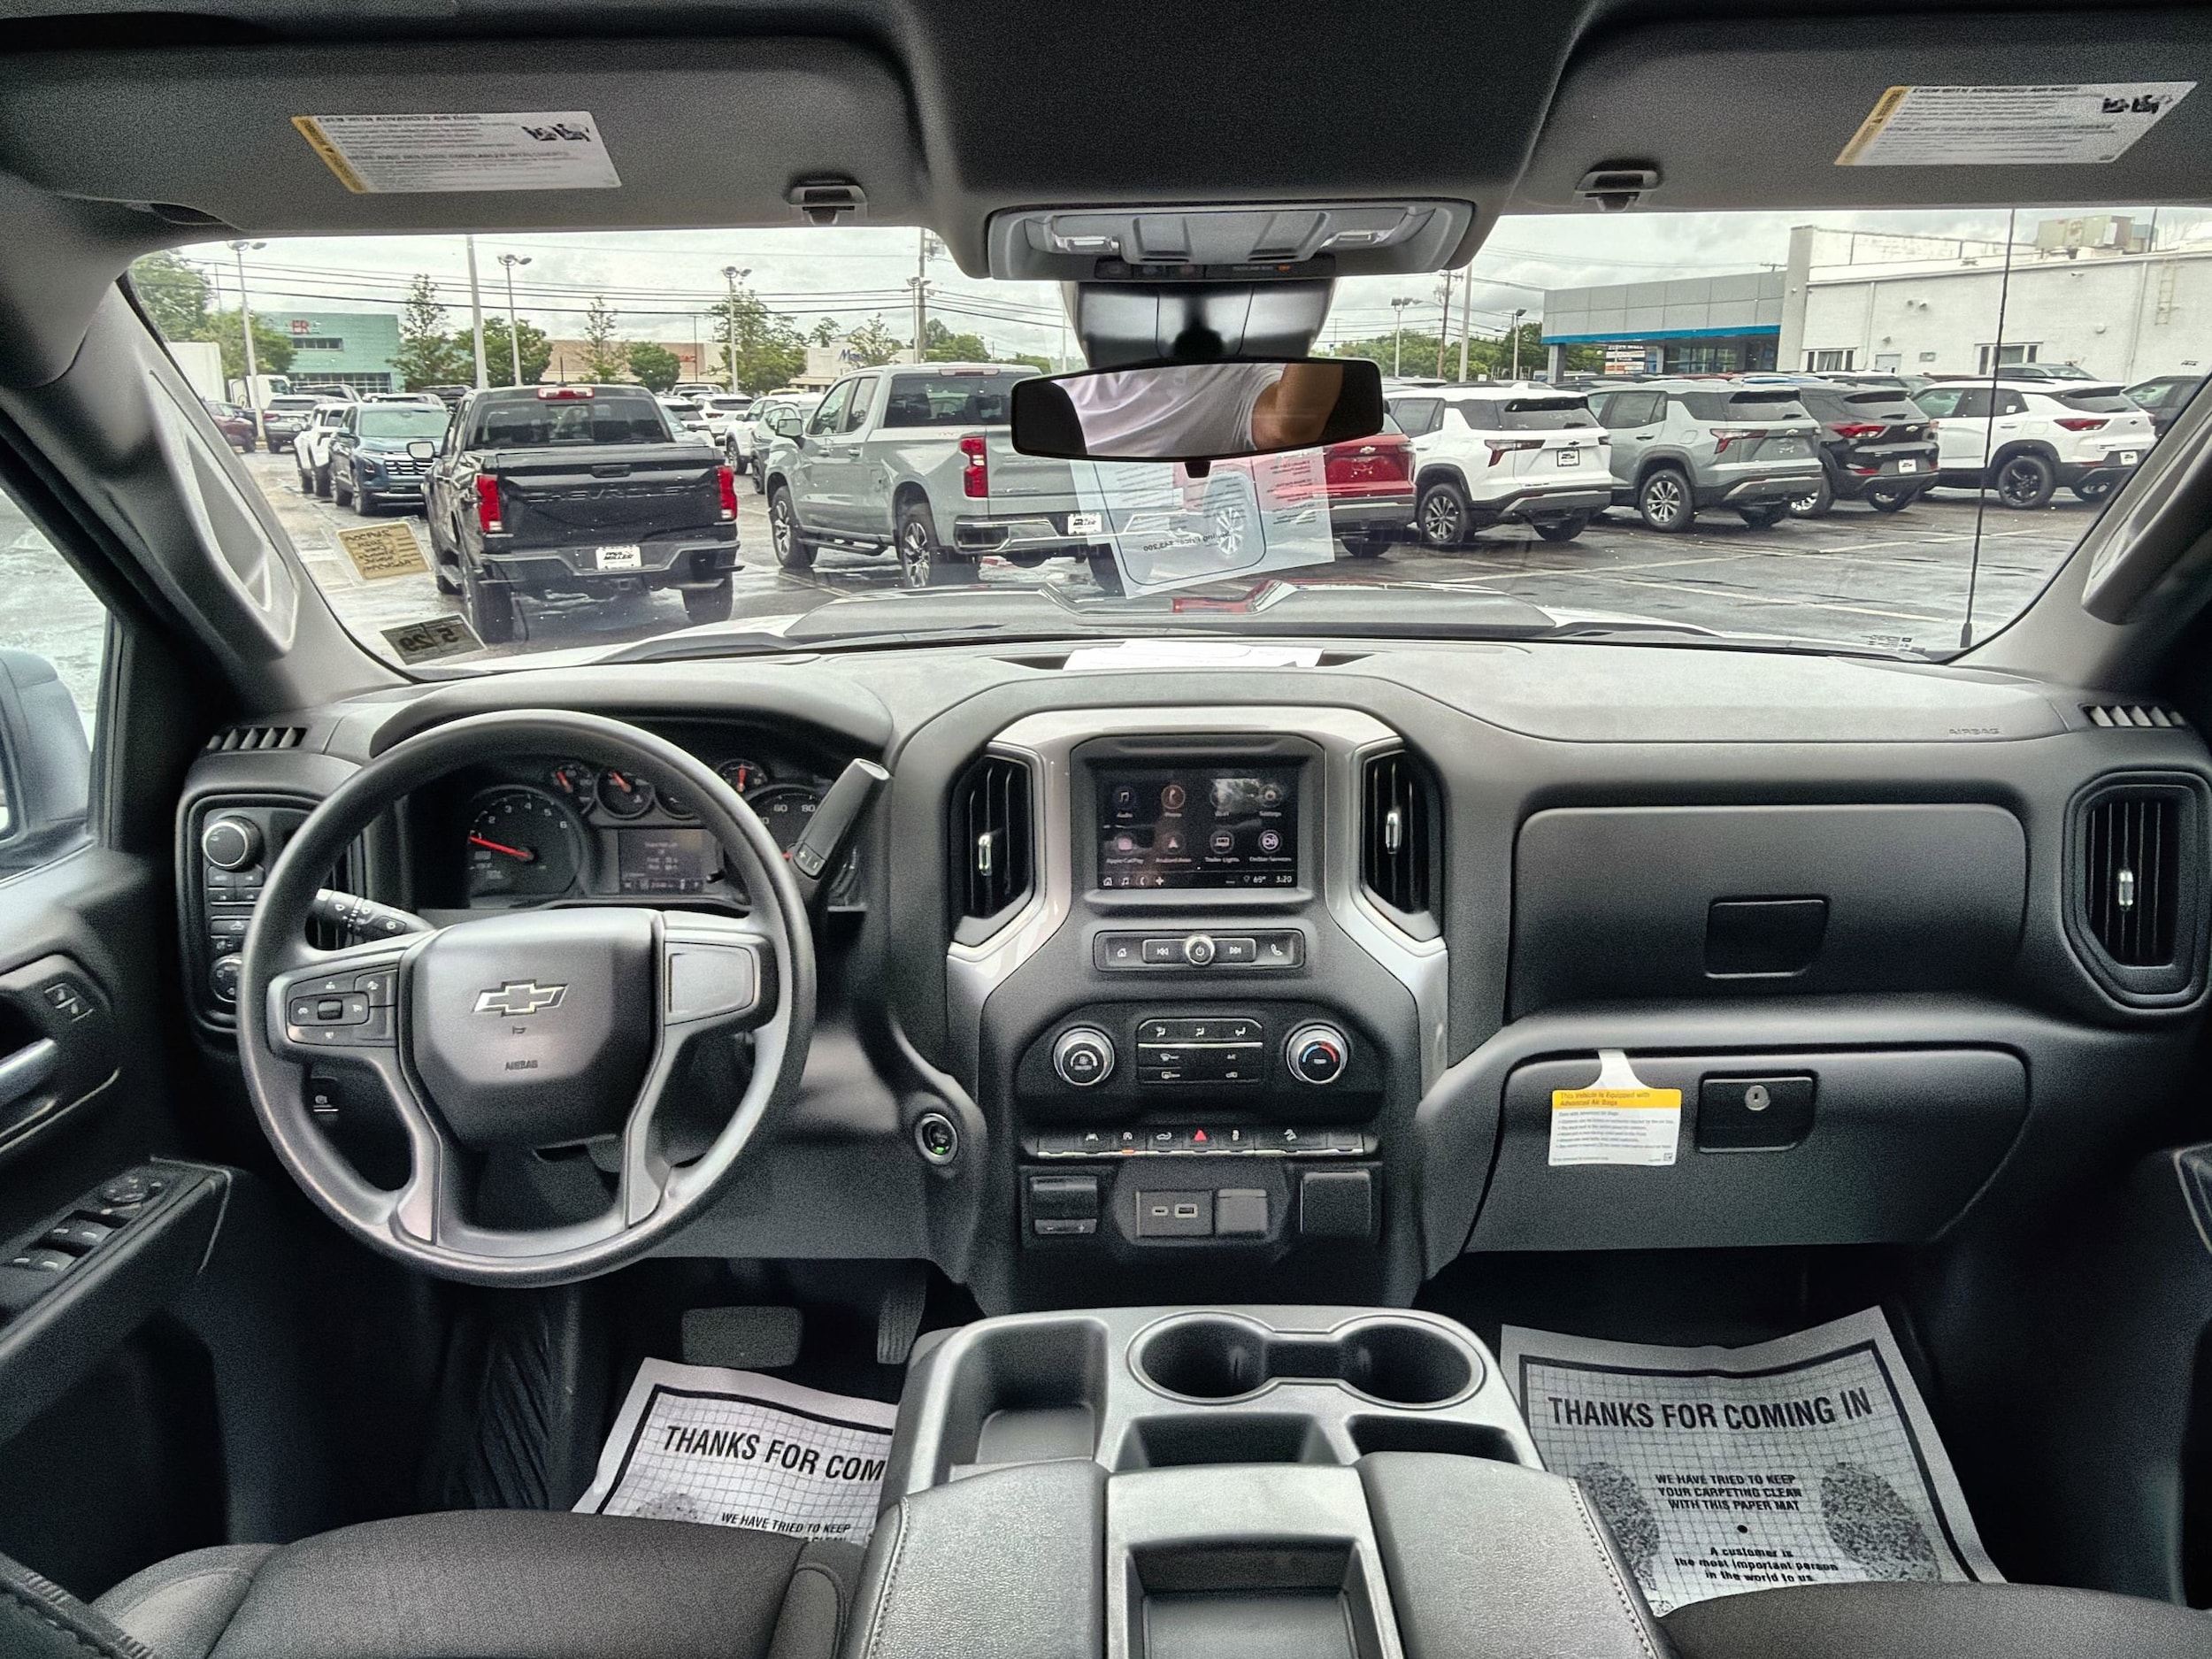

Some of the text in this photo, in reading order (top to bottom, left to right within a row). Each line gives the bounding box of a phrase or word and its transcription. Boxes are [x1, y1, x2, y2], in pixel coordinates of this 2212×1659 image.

[801, 803, 816, 812] 80
[559, 820, 568, 829] 6
[1548, 1386, 1873, 1430] THANKS FOR COMING IN
[664, 1425, 886, 1481] THANKS FOR COM
[1655, 1474, 1796, 1485] WE HAVE TRIED TO KEEP
[1658, 1487, 1802, 1497] YOUR CARPETING CLEAN
[1668, 1500, 1801, 1511] WITH THIS PAPER MAT
[721, 1512, 851, 1533] WE HAVE TRIED TO KEEP
[1709, 1547, 1794, 1557] A customer is
[1675, 1557, 1839, 1571] the most important person
[1705, 1570, 1717, 1579] in
[1720, 1571, 1740, 1581] the
[1744, 1571, 1778, 1582] world
[1782, 1572, 1794, 1582] to
